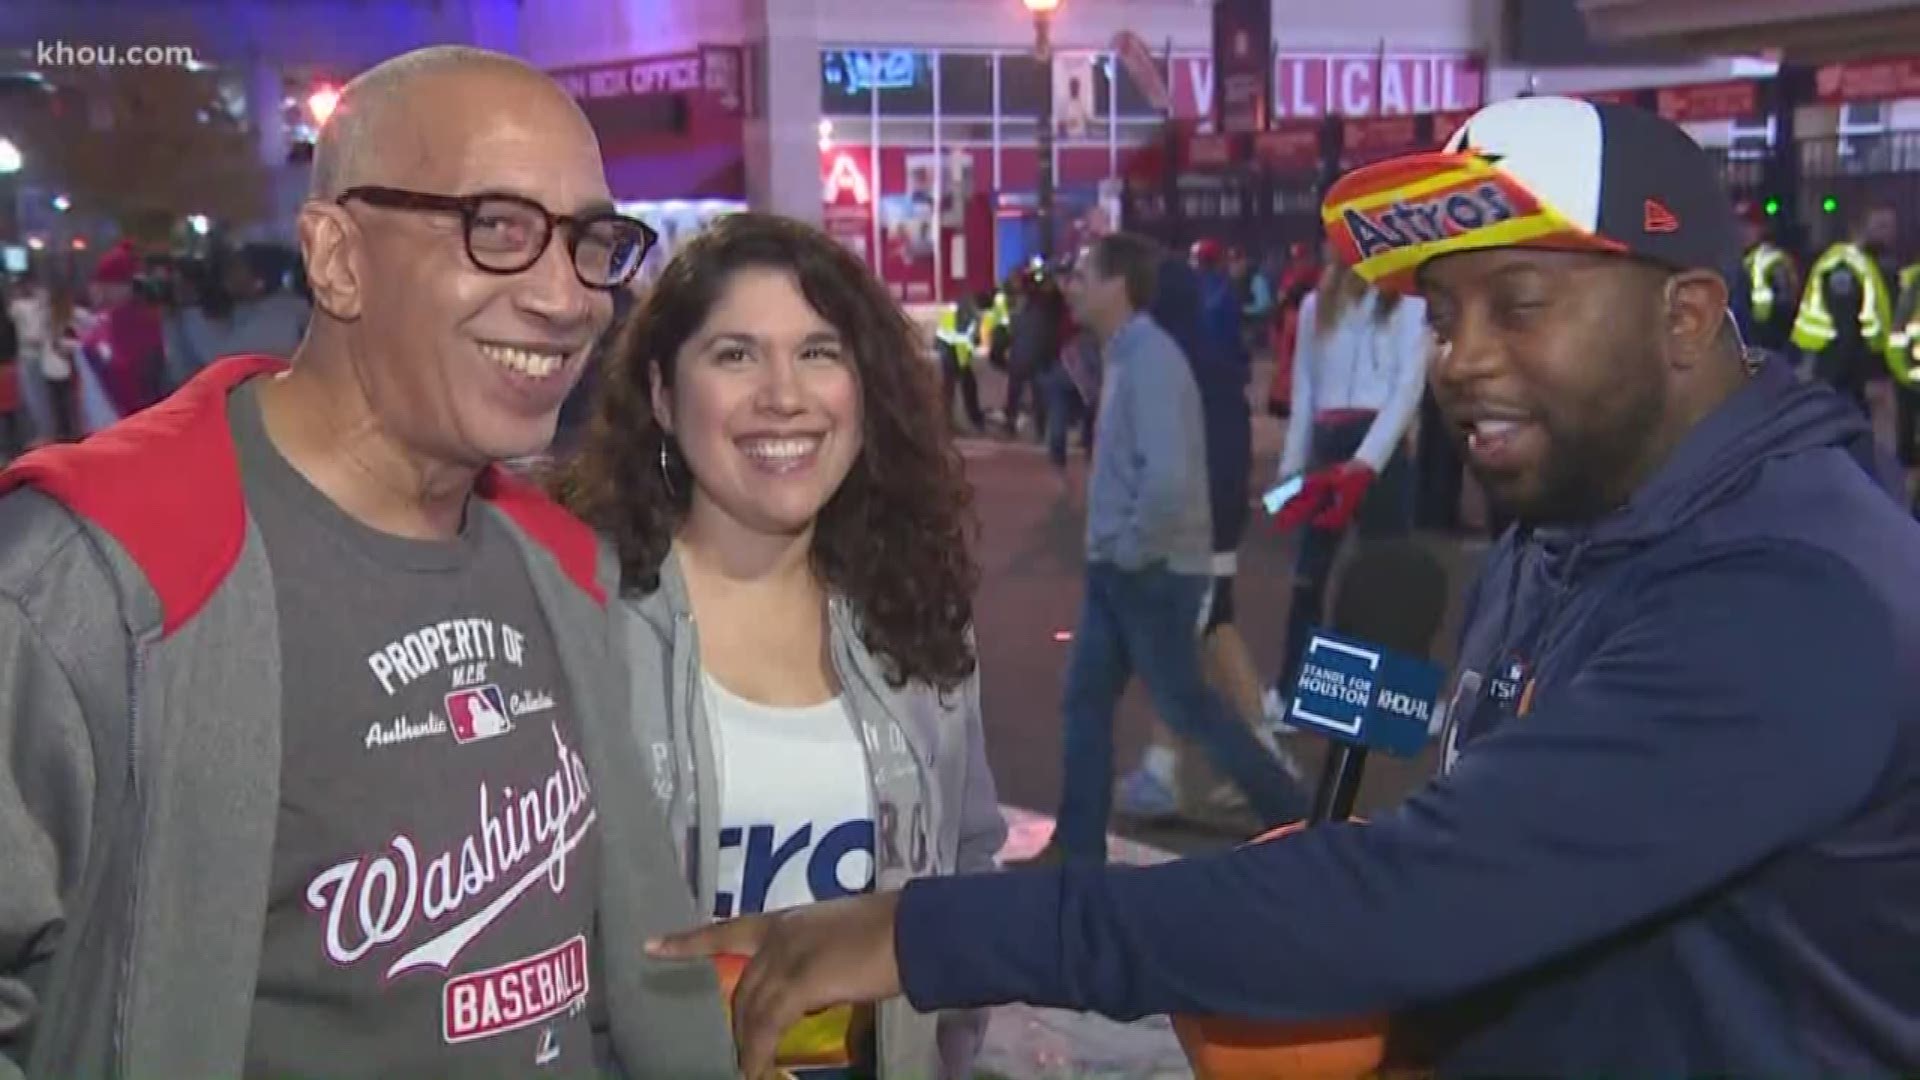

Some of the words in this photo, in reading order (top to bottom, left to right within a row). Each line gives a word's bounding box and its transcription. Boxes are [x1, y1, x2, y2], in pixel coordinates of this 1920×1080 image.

[632, 58, 700, 93] OFFICE
[1340, 58, 1468, 117] CALL
[1343, 182, 1515, 259] Astros
[368, 618, 496, 696] PROPERTY
[502, 623, 526, 668] OF
[1303, 662, 1346, 685] STANDS
[1348, 676, 1372, 692] FOR
[1298, 674, 1371, 708] HOUSTON
[364, 710, 449, 750] Authentic
[453, 948, 583, 1034] BASEBALL
